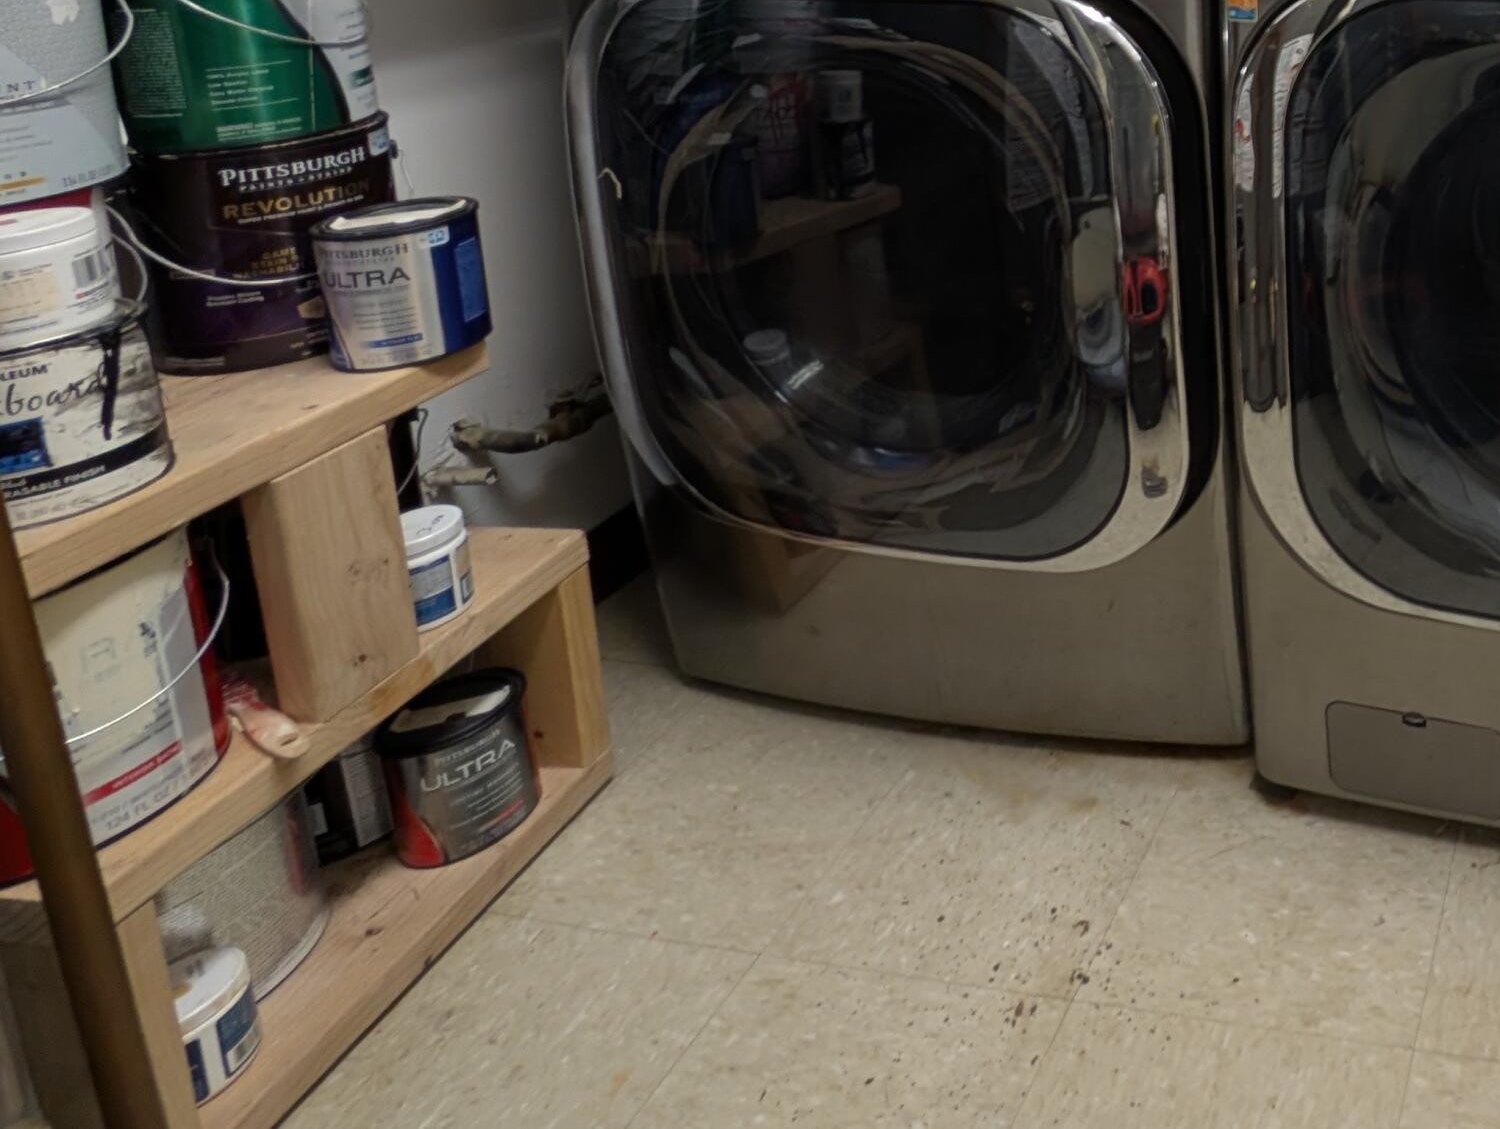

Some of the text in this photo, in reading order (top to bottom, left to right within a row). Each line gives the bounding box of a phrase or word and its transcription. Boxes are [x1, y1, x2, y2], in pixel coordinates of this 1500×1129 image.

[217, 146, 366, 187] PITTSBURGH
[223, 181, 370, 220] REVOLUTION
[324, 266, 411, 289] ULTRA
[420, 738, 516, 792] ULTRA
